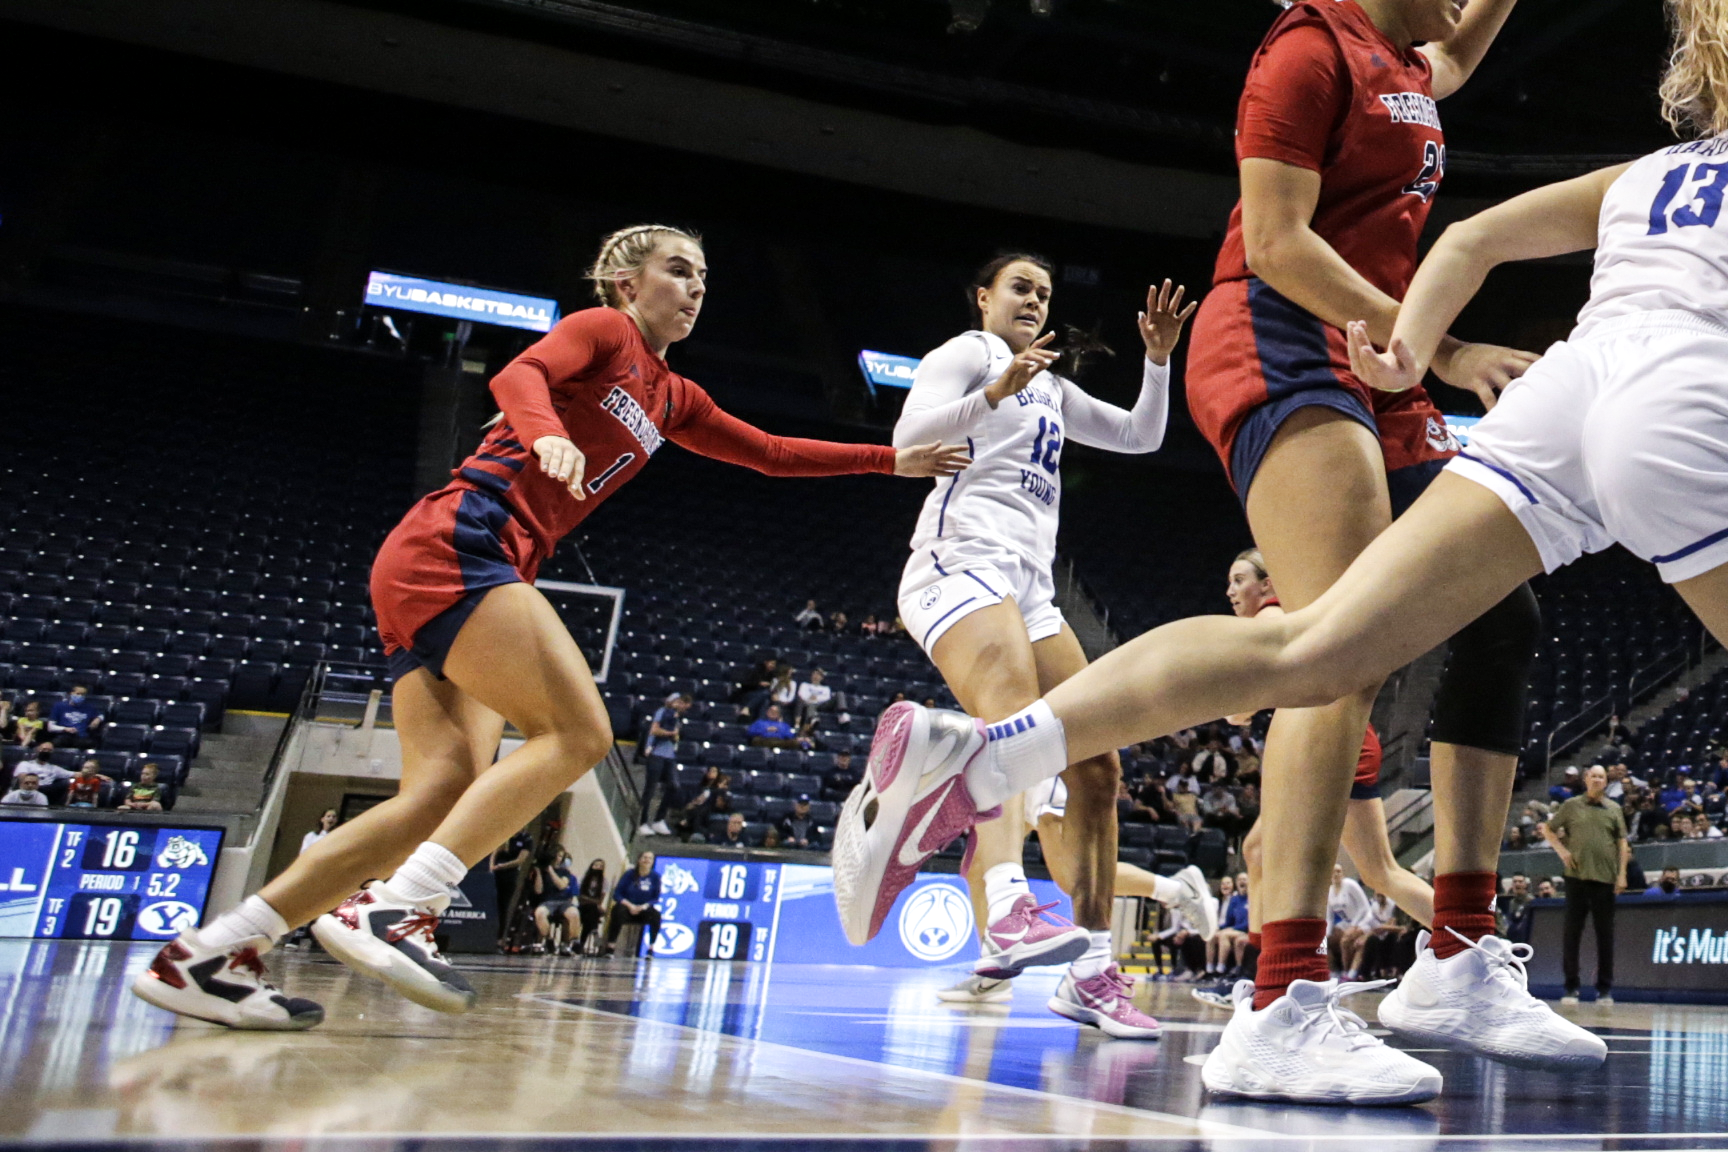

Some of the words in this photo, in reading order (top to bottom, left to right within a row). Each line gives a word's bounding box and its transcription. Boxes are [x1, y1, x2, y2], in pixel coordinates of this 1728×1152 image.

[367, 282, 551, 322] BYUBASKETBALL
[1030, 416, 1060, 475] 12
[588, 453, 635, 494] 1
[1020, 469, 1056, 505] YOUNG
[67, 831, 83, 847] TF
[102, 831, 140, 868] 16
[61, 849, 76, 868] 2
[79, 874, 125, 890] PERIOD
[132, 876, 141, 890] 1
[147, 873, 181, 897] 5.2
[719, 864, 747, 900] 16
[765, 869, 777, 884] TF
[48, 899, 65, 914] TF
[762, 885, 773, 903] 2
[83, 898, 122, 936] 19
[703, 902, 739, 919] PERIOD
[43, 917, 57, 936] 3
[709, 923, 738, 959] 19
[753, 943, 765, 962] 3
[1653, 926, 1686, 964] It's
